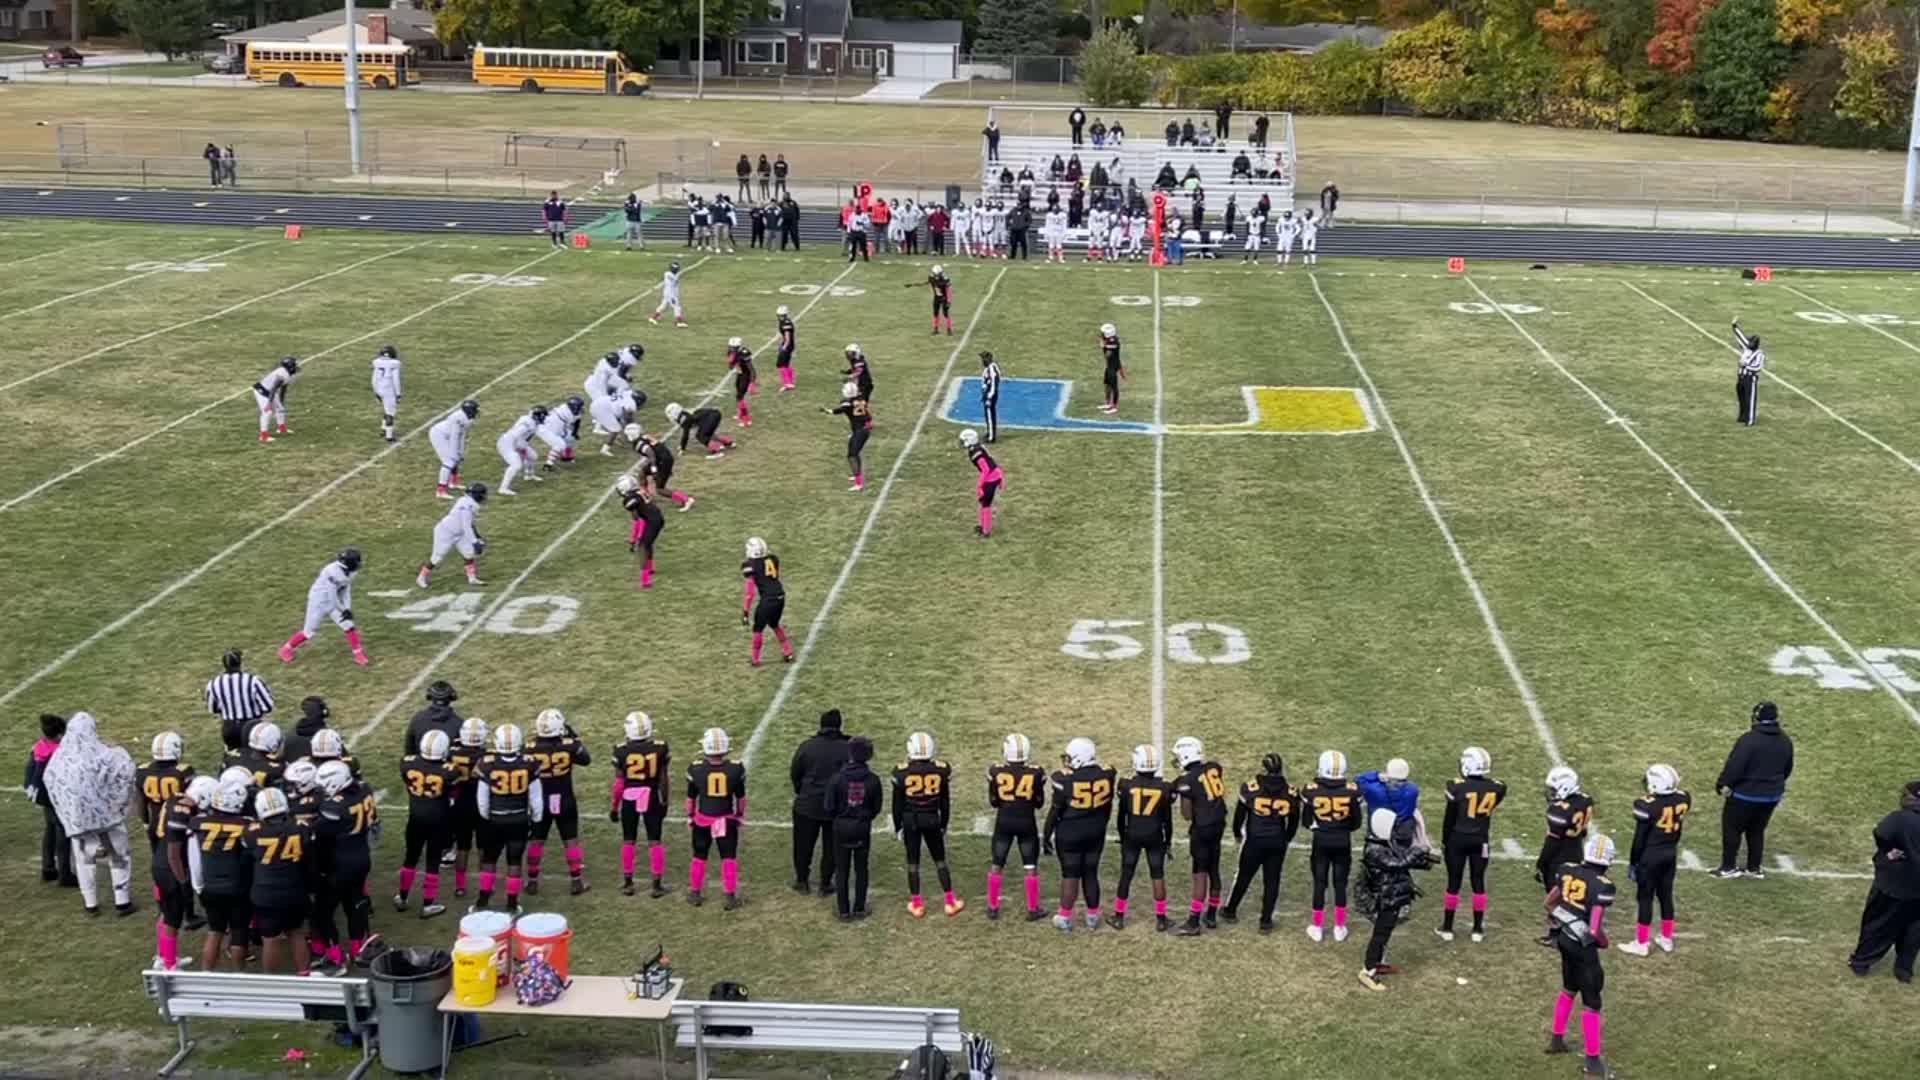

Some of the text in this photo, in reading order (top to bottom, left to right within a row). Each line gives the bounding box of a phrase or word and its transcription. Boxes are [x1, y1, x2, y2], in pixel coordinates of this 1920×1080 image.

[764, 555, 779, 579] 4
[384, 592, 580, 635] 40
[1059, 618, 1252, 665] 50
[533, 751, 571, 777] 22
[626, 752, 658, 780] 21
[143, 775, 180, 803] 40
[406, 768, 444, 798] 33
[490, 769, 529, 795] 30
[706, 771, 729, 797] 0
[904, 773, 941, 796] 28
[997, 772, 1035, 801] 24
[1070, 778, 1111, 809] 52
[1199, 766, 1226, 801] 16
[1129, 787, 1163, 816] 17
[1313, 796, 1352, 821] 25
[1465, 791, 1497, 818] 14
[1656, 802, 1689, 833] 43
[200, 821, 244, 851] 77
[256, 834, 303, 865] 74
[1561, 874, 1587, 911] 12
